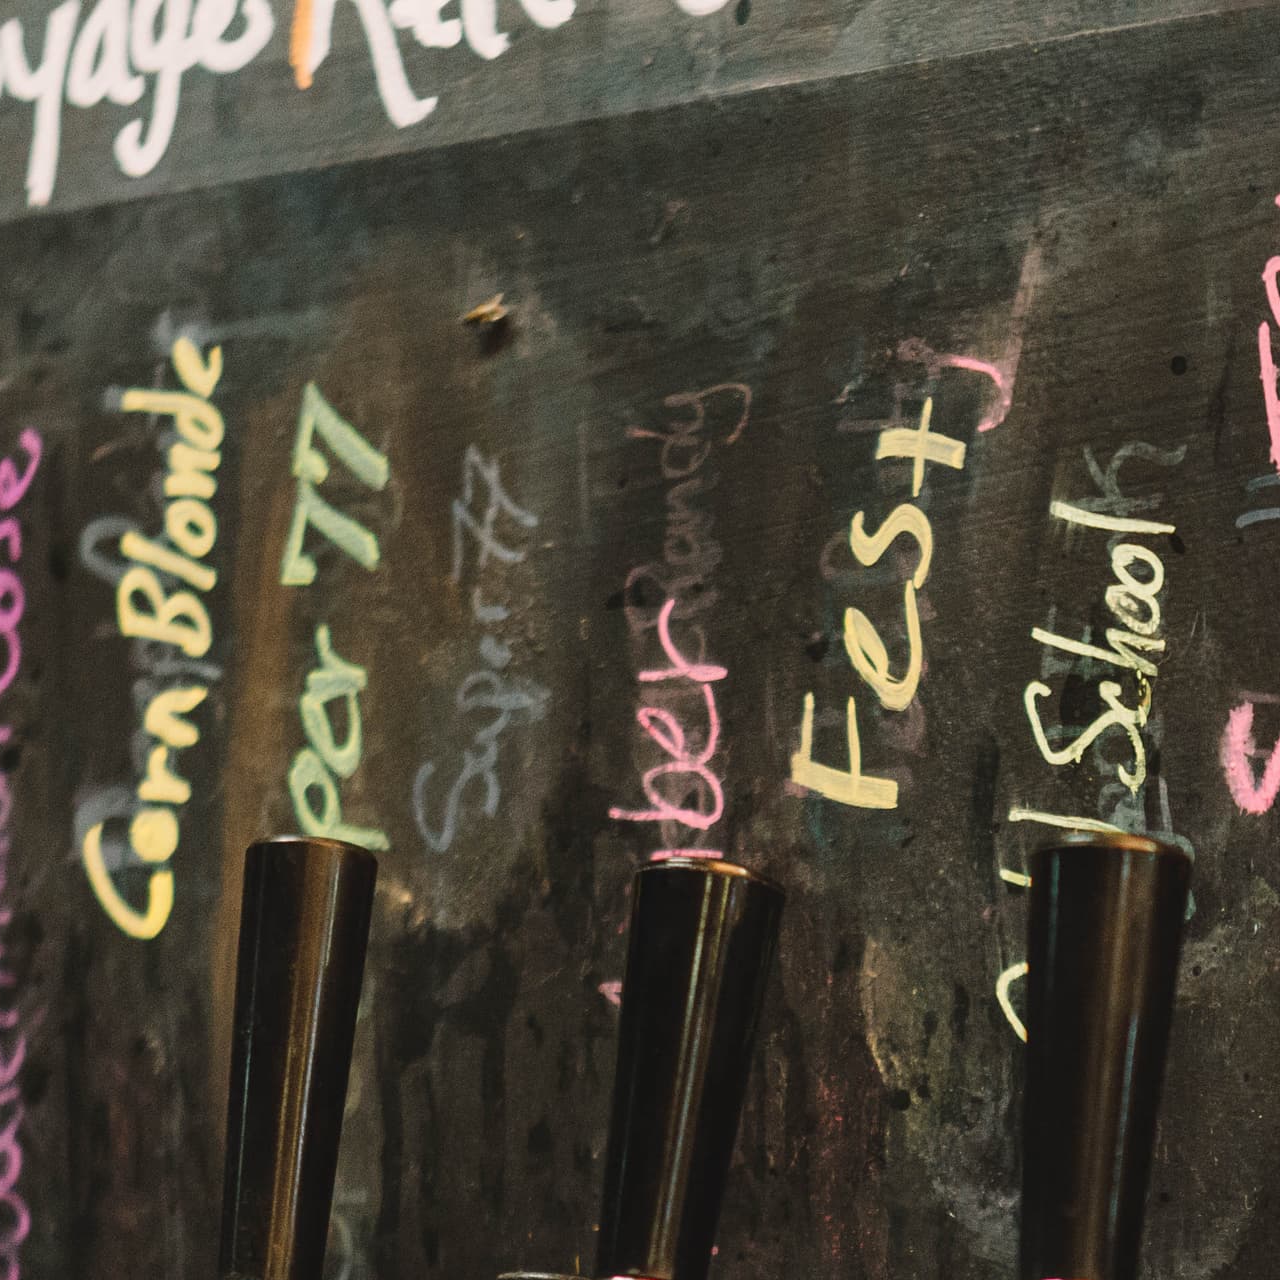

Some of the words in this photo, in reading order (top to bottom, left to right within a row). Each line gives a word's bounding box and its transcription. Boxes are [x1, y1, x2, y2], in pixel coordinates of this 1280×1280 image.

[117, 335, 224, 658] Blonde
[280, 380, 390, 586] 77
[790, 395, 966, 810] Fest
[286, 624, 390, 852] per
[1024, 497, 1176, 798] School
[81, 684, 208, 940] Corn
[599, 599, 728, 1004] ber
